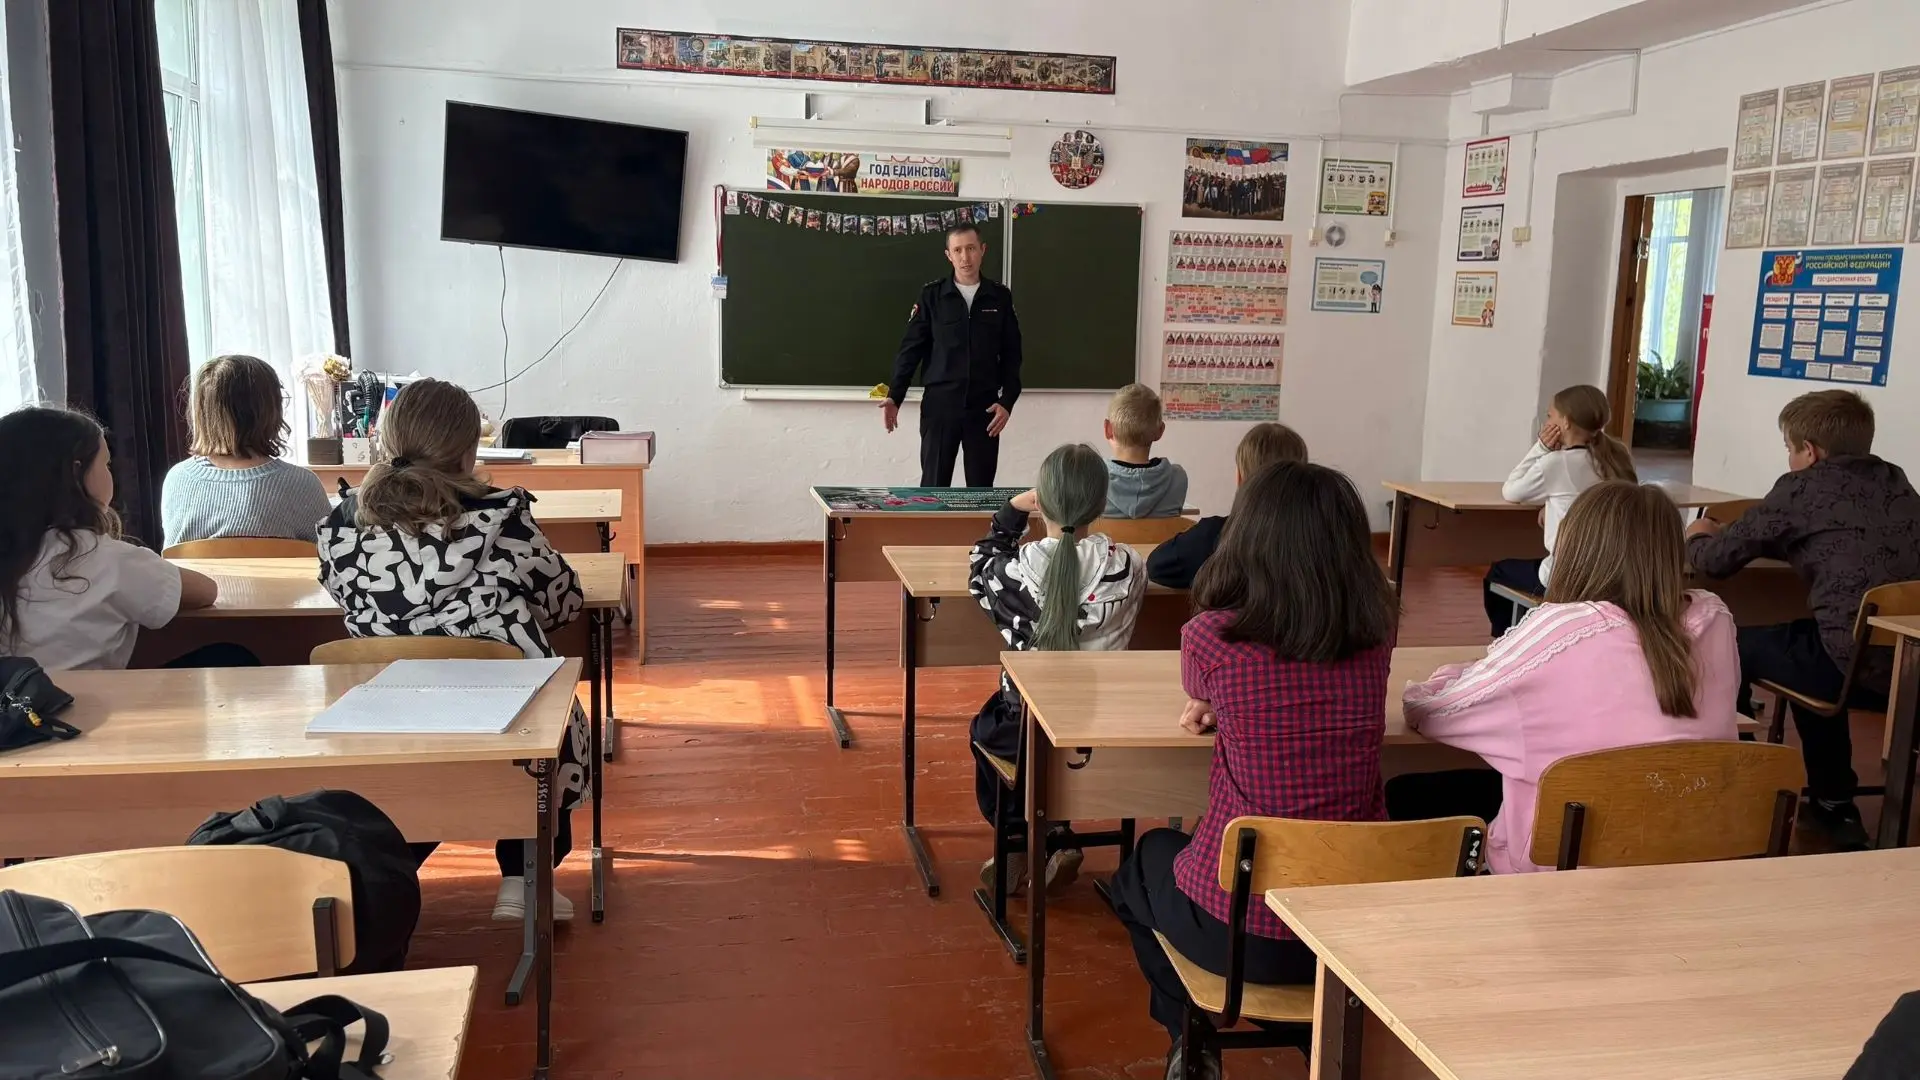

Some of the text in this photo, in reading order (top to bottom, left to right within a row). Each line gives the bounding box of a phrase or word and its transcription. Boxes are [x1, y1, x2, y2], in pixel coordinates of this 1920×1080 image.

[869, 163, 946, 178] ГОД ЕДИНСТВА
[861, 178, 955, 193] НАРОДОВ РОССИИ
[1805, 261, 1849, 269] РОССИЙСКОЙ
